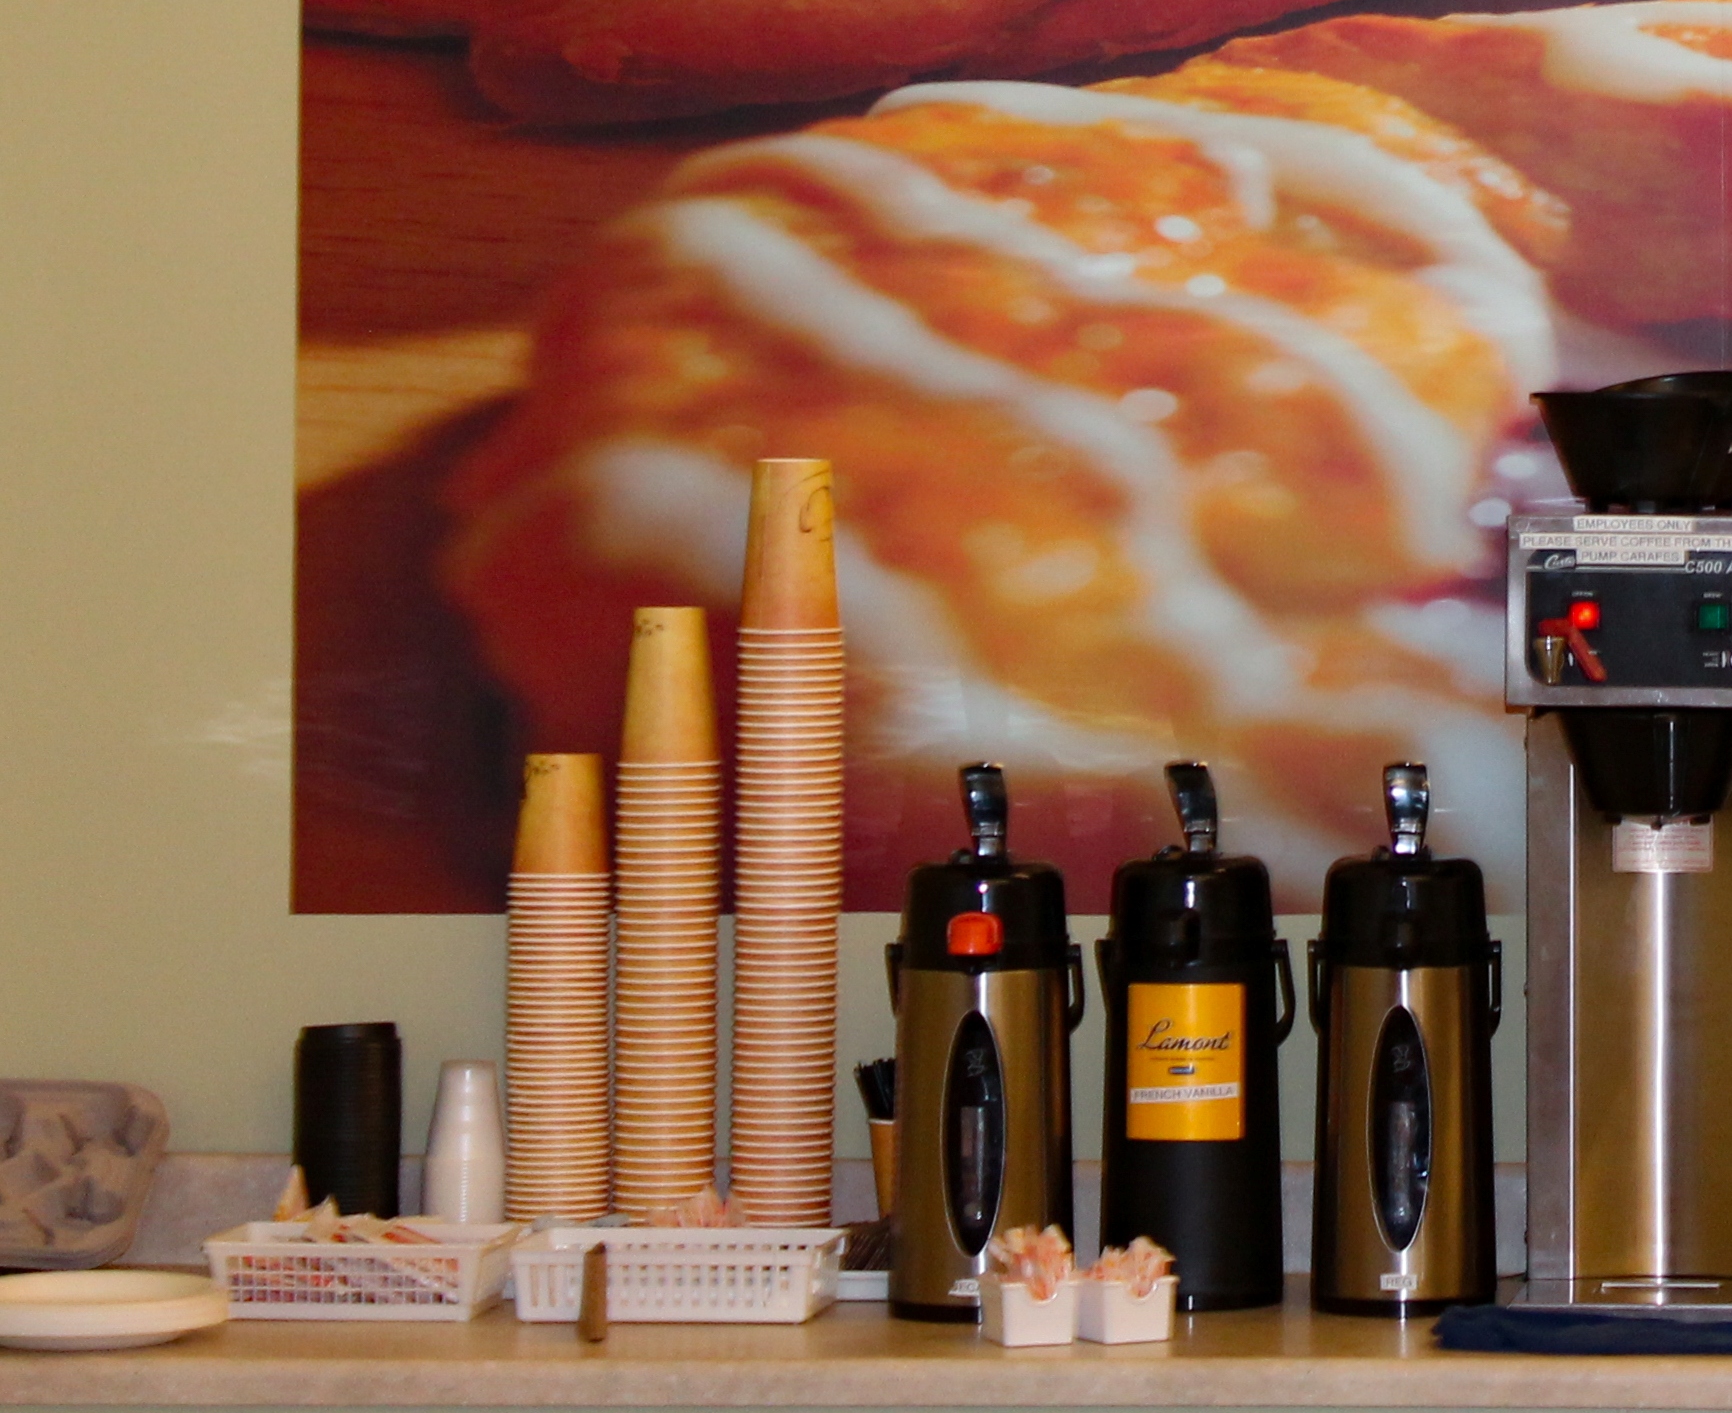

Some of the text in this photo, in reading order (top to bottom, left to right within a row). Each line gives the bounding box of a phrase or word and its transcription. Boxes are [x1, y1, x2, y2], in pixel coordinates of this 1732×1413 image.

[1576, 518, 1692, 531] EMPLOYEES ONLY
[1522, 536, 1571, 548] PLEASE
[1574, 536, 1617, 548] SERVE
[1620, 537, 1671, 548] COFFEE
[1674, 538, 1711, 548] FROM
[1581, 552, 1680, 562] PUMP CARAFES
[1684, 560, 1722, 575] C500
[1136, 1019, 1232, 1051] Lamont
[1133, 1086, 1234, 1101] FRENCH VANILLA
